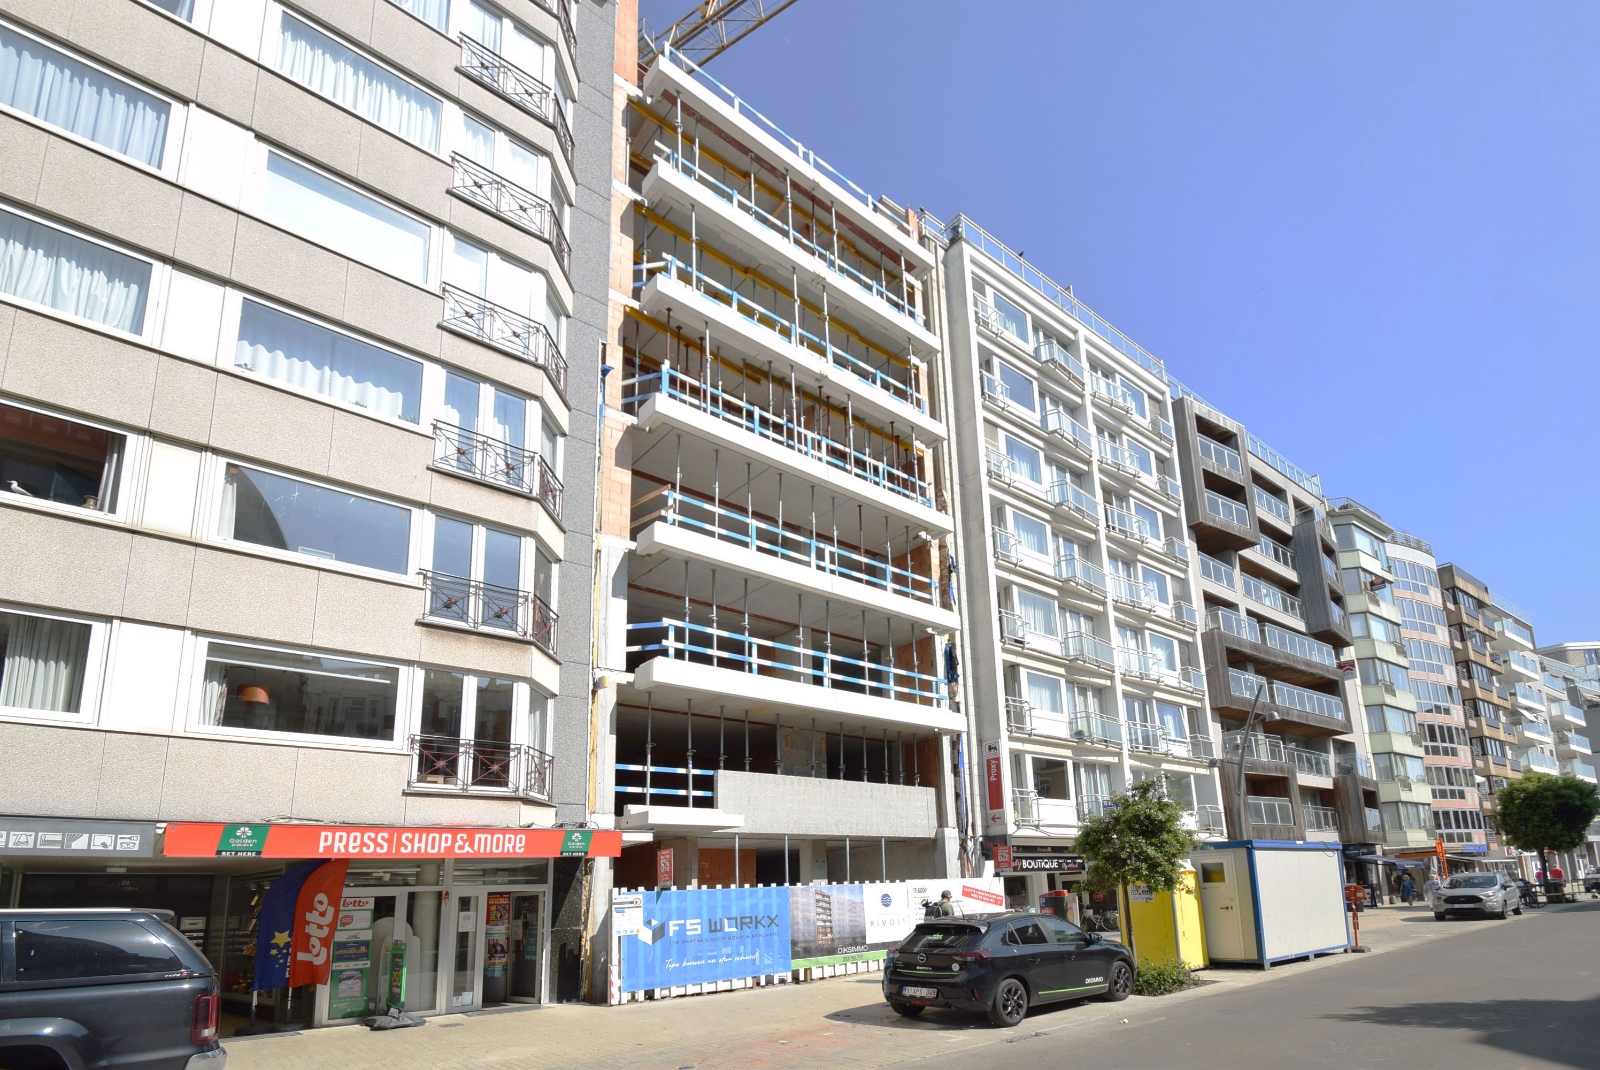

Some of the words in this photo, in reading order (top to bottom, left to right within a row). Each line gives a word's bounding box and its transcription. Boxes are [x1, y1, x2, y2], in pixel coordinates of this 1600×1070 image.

[989, 759, 998, 781] Proxy
[318, 831, 389, 854] PRESS
[1022, 859, 1059, 869] BOUTIQUE
[341, 898, 369, 908] Lotto
[296, 892, 335, 966] Lotto
[668, 918, 702, 937] FS
[708, 914, 779, 933] WORKX
[869, 917, 906, 928] RIVOLI
[681, 937, 708, 945] PARTNER
[751, 931, 780, 939] RENOVATIE
[837, 944, 869, 955] DIKSIMMO
